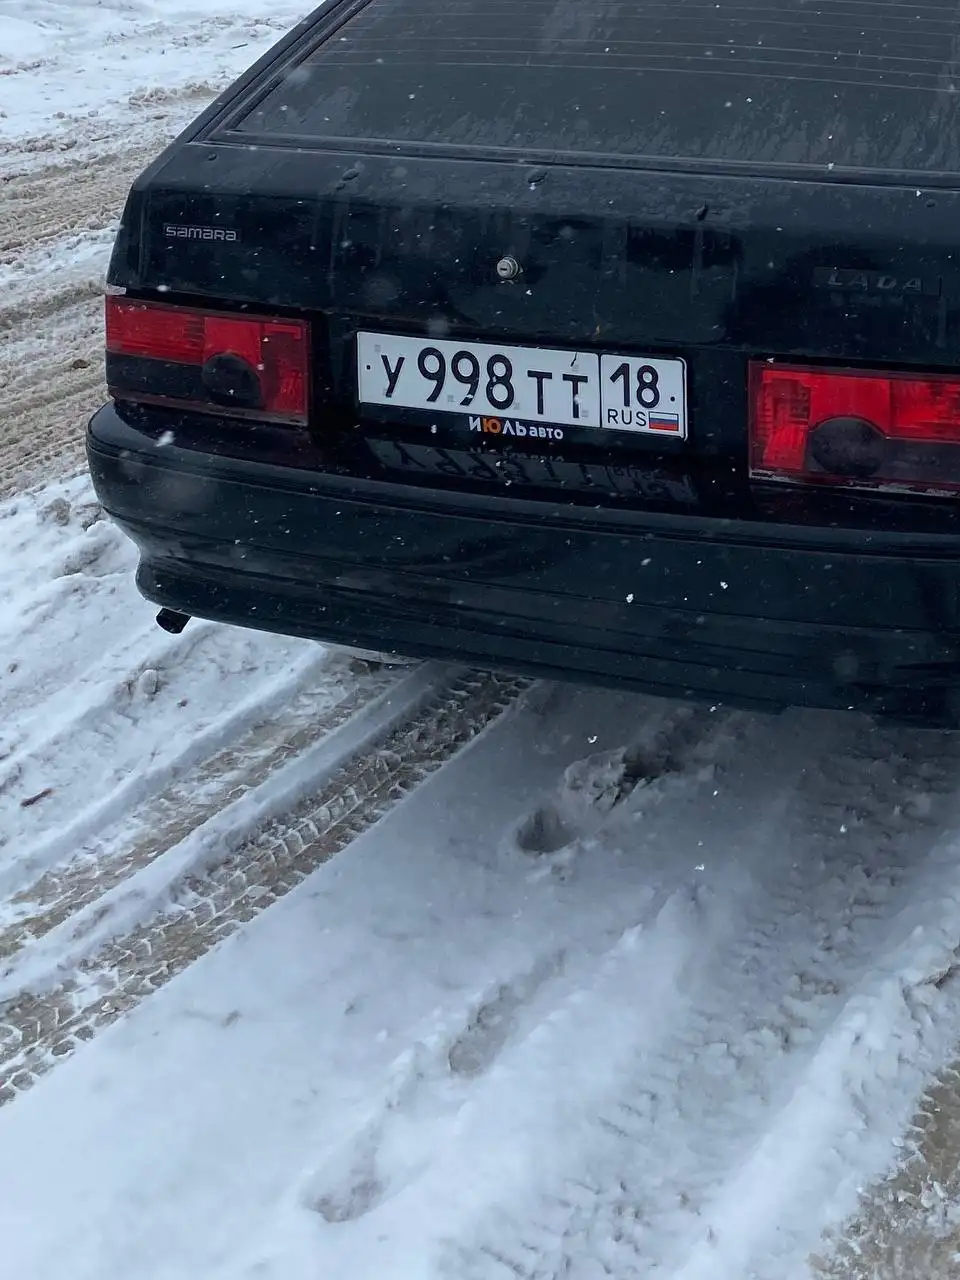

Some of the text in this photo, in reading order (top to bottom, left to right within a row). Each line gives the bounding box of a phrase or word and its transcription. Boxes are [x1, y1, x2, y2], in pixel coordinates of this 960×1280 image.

[827, 271, 921, 291] LADA
[610, 363, 660, 409] 18
[469, 416, 527, 437] ИЮЛЬ
[607, 408, 647, 426] RUS
